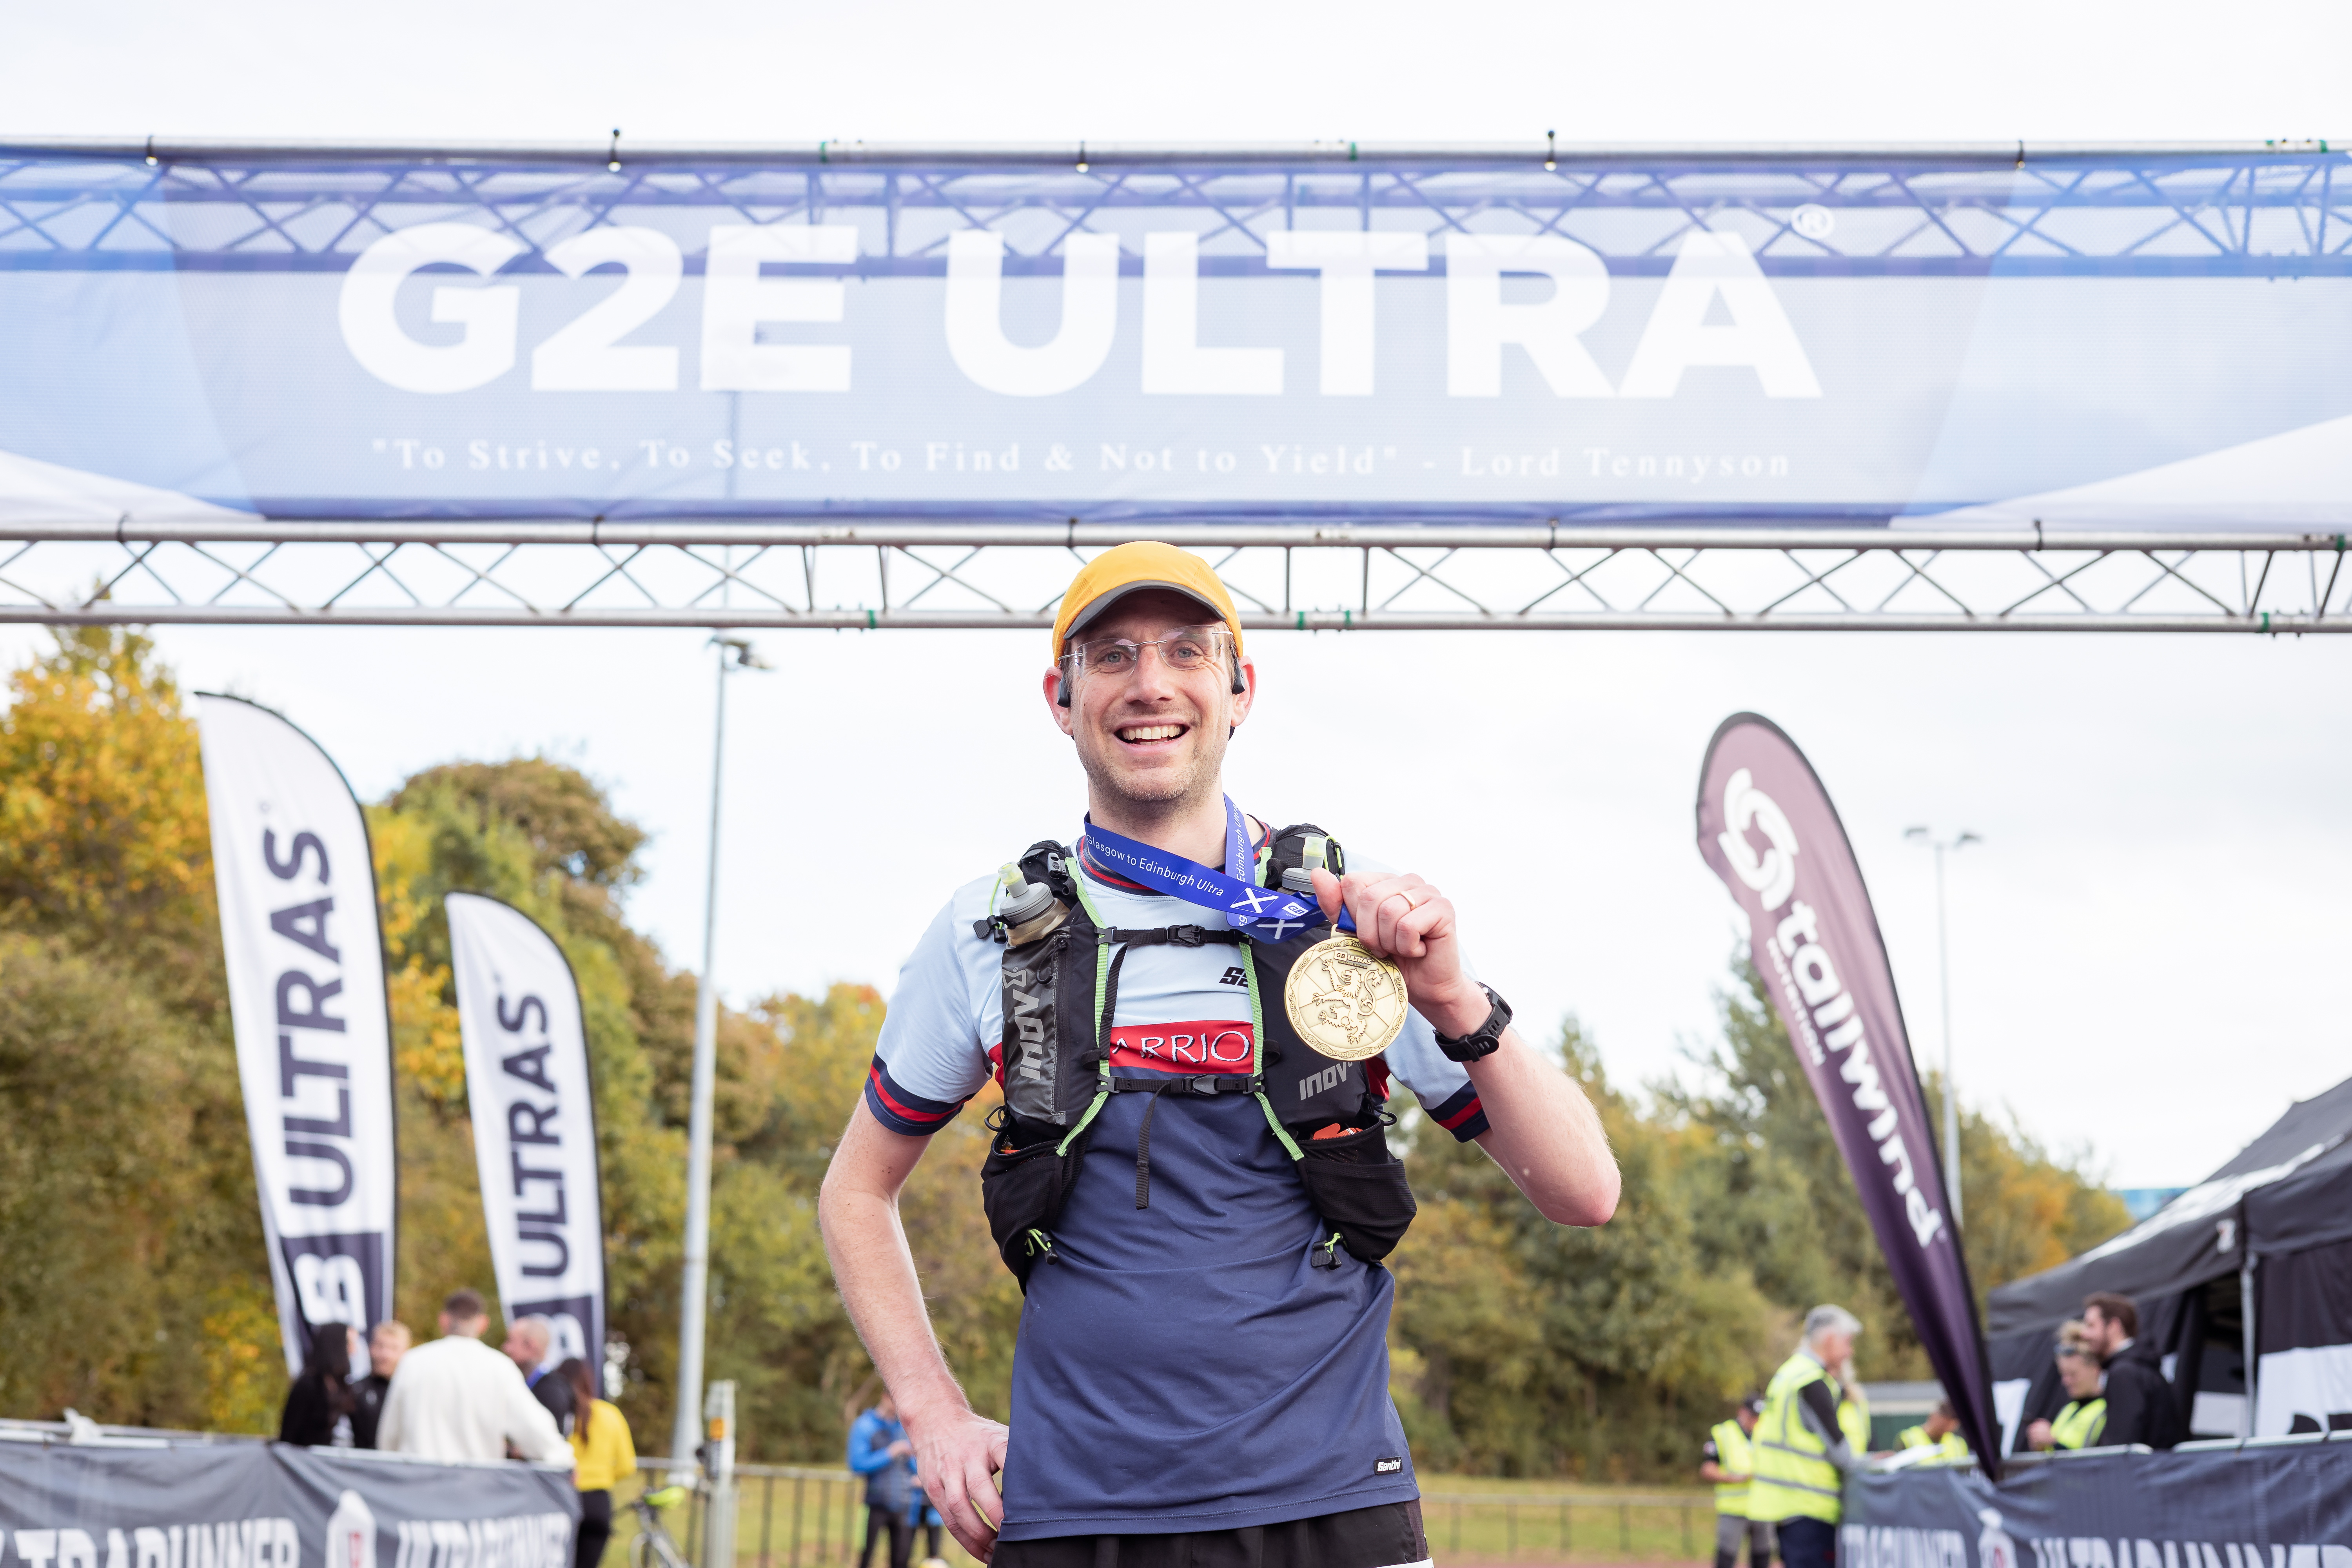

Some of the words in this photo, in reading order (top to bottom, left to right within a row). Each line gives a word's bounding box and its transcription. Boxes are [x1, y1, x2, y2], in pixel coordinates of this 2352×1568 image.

[338, 223, 858, 393] G2E
[639, 438, 691, 469] To
[851, 441, 902, 471] To
[926, 441, 1020, 472] Find
[1044, 443, 1074, 472] &
[1100, 443, 1171, 472] Not
[1197, 448, 1237, 472] to
[1461, 447, 1560, 477] Lord
[1583, 447, 1790, 484] Tennyson
[1232, 804, 1242, 828] Ultra
[1086, 834, 1125, 860] Glasgow
[1127, 853, 1136, 866] to
[1139, 857, 1195, 886] Edinburgh
[1196, 878, 1224, 897] Ultra
[1235, 830, 1245, 882] Edinburgh
[1288, 905, 1305, 914] GB
[1318, 942, 1341, 952] Glasgow
[1293, 970, 1299, 980] GB
[1297, 956, 1309, 971] Ultras
[1395, 976, 1402, 985] GB
[261, 828, 354, 1208] ULTRAS
[1314, 1042, 1327, 1051] Find
[1377, 1038, 1388, 1049] Lord
[1387, 1014, 1403, 1039] Tennyson
[496, 992, 571, 1278] ULTRAS
[1377, 1459, 1401, 1472] Santini
